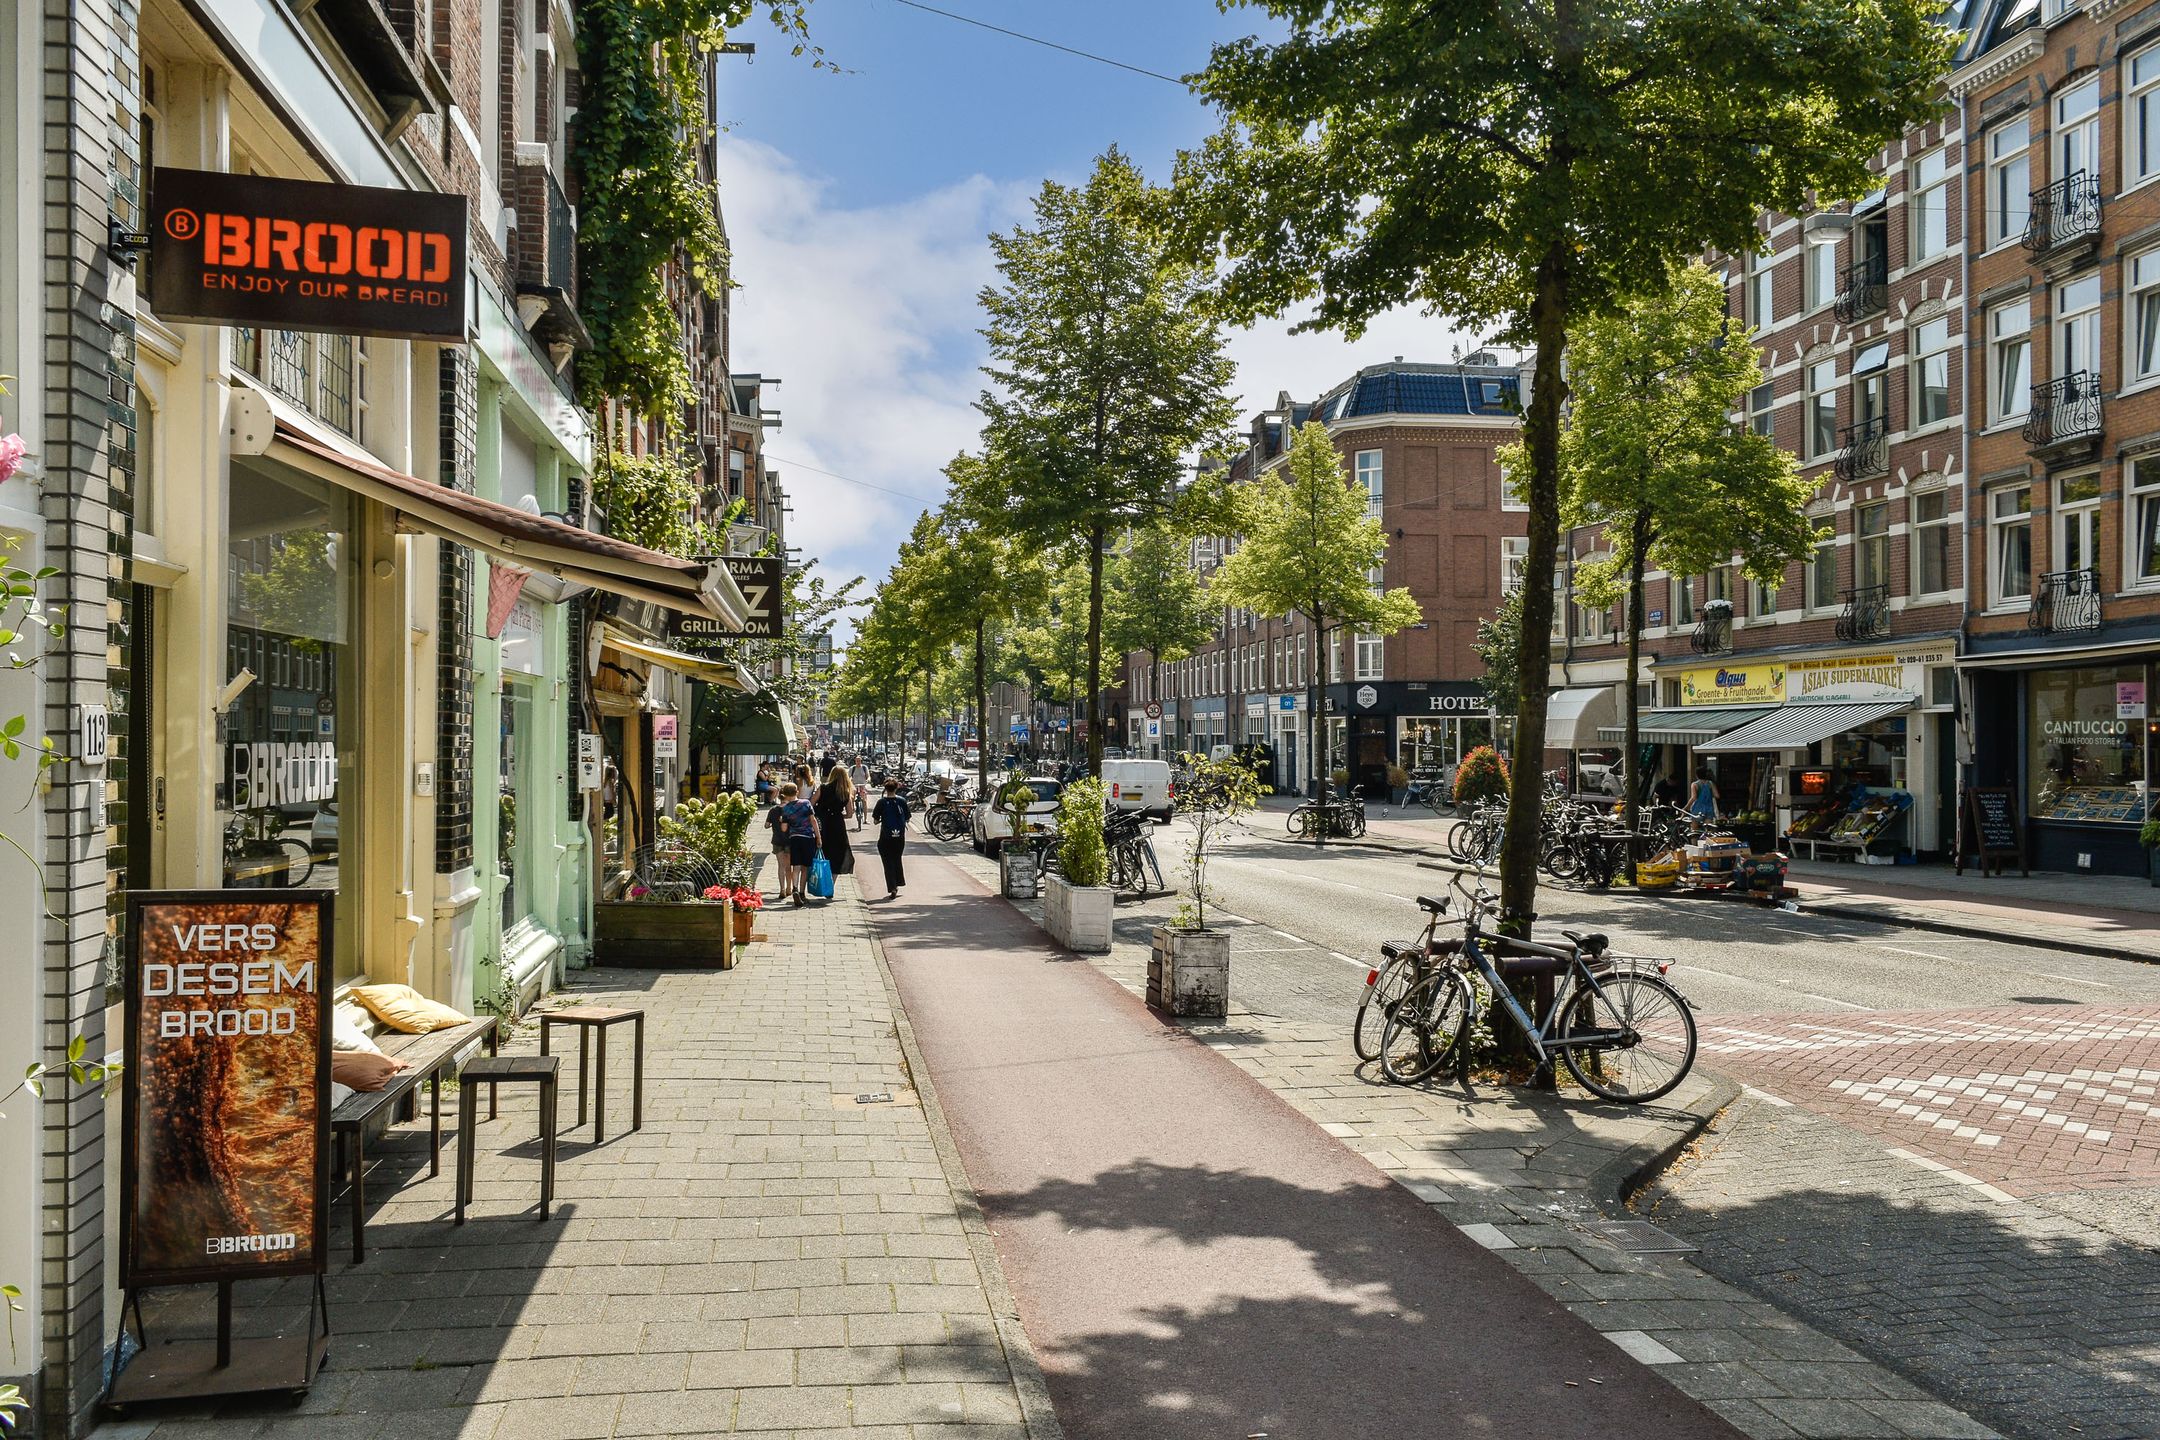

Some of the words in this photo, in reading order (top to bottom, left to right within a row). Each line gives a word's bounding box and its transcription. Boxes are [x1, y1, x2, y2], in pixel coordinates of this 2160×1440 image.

[203, 213, 451, 284] BROOD
[203, 272, 289, 296] ENJOY
[298, 279, 349, 301] OUR
[357, 286, 449, 308] BREAD!
[729, 560, 766, 575] RMA
[680, 620, 771, 634] GRILLOM
[1729, 684, 1767, 697] Fruithandel
[1801, 670, 1829, 695] ASIAN
[1830, 665, 1904, 690] SUPERMARKET
[1148, 706, 1159, 714] 30
[1429, 696, 1489, 710] HOTEL
[86, 714, 106, 757] 113
[2043, 720, 2127, 735] CANTUCCIO
[2052, 736, 2077, 745] ITALIAN
[2077, 737, 2094, 745] FOOD
[2094, 737, 2116, 746] STORE
[172, 923, 277, 952] VERS
[143, 961, 315, 997] DESEM
[160, 1007, 297, 1039] BROOD
